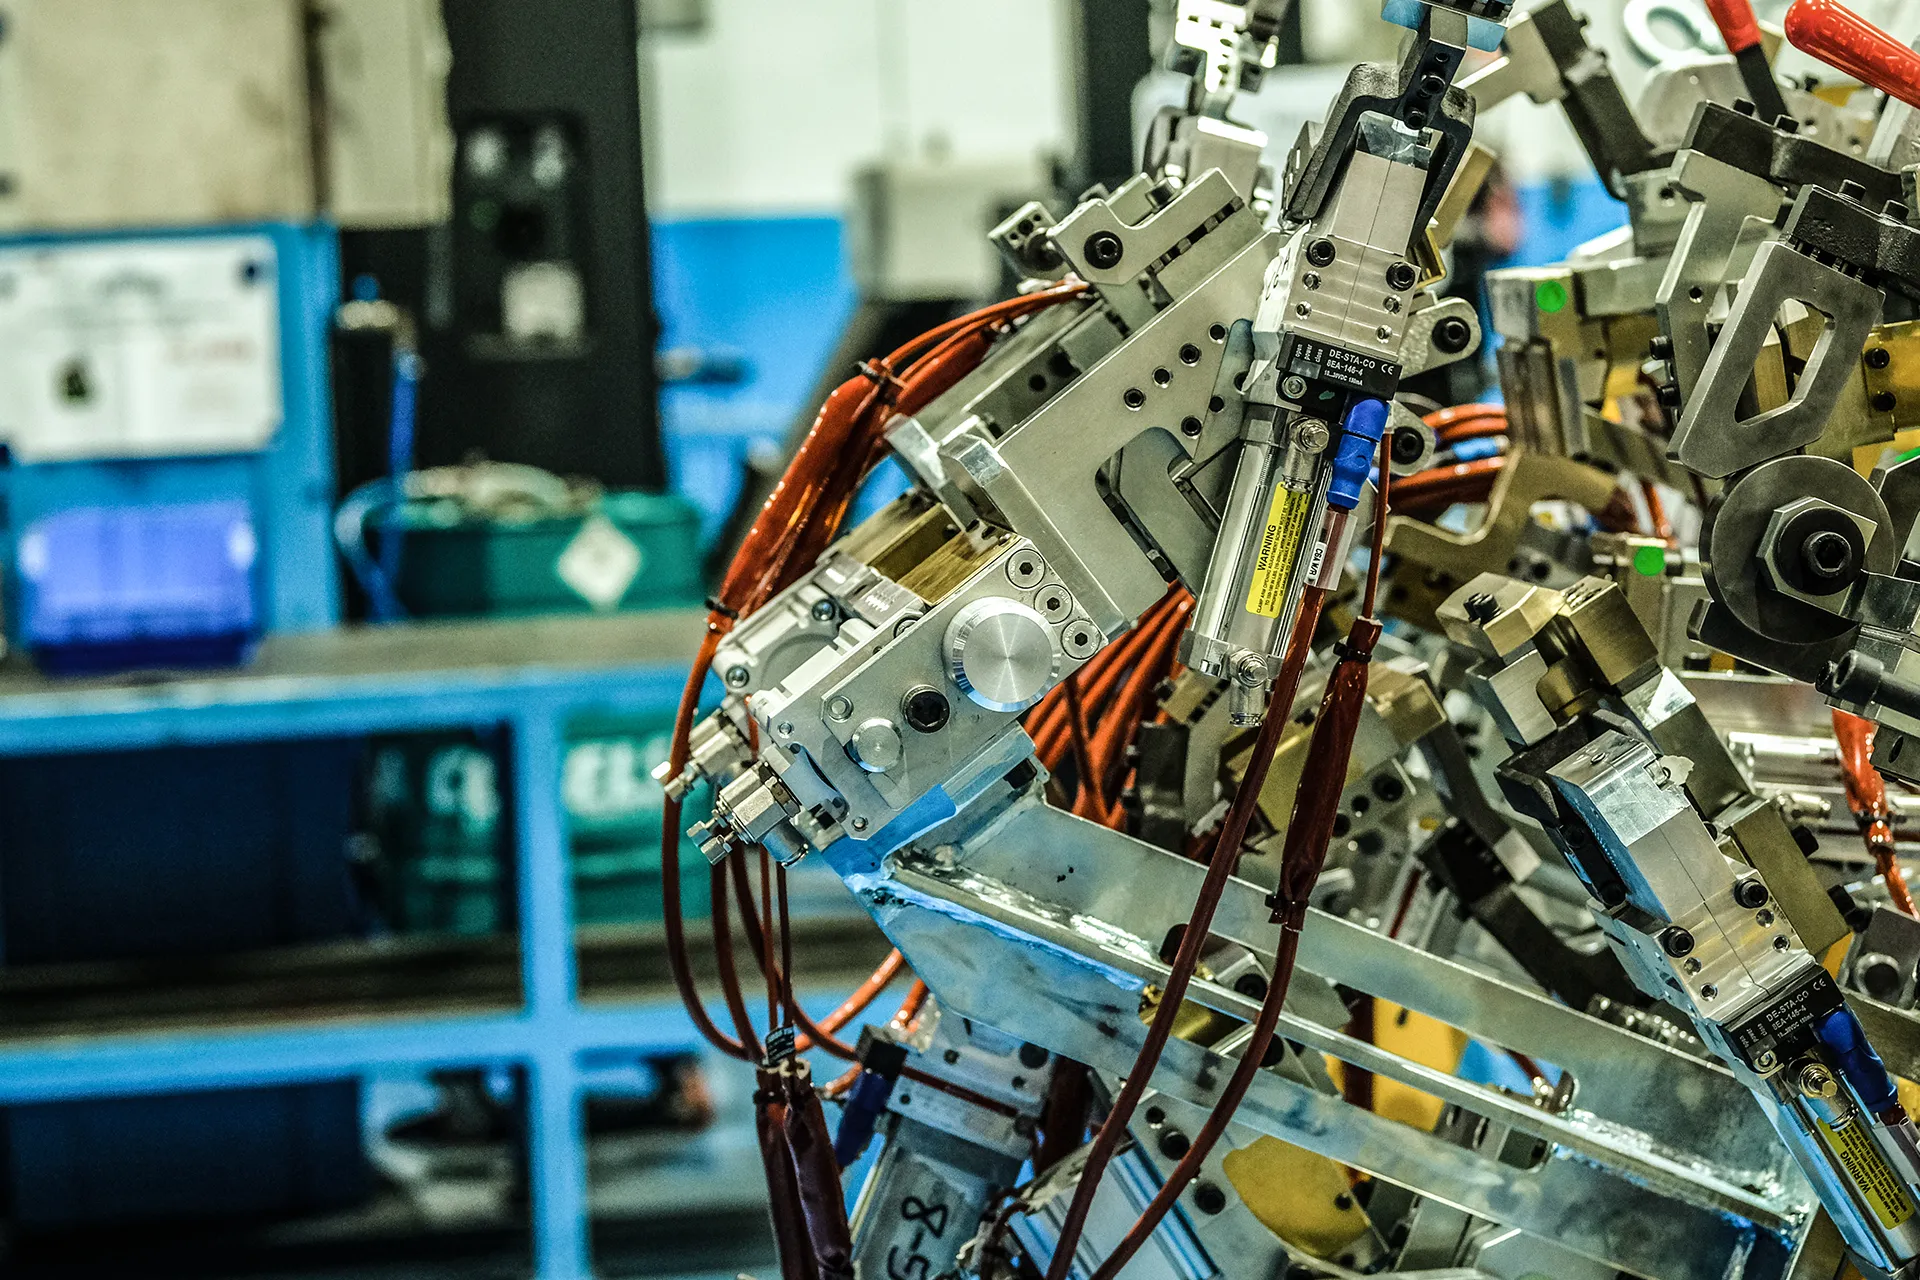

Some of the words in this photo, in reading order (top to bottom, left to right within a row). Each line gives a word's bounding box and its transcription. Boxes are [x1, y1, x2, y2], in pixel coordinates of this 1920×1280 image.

[1328, 348, 1376, 369] DE-STA-CO
[1257, 524, 1276, 571] WARNING
[1766, 990, 1810, 1022] DE-STA-CO
[1839, 1150, 1871, 1193] WARNING
